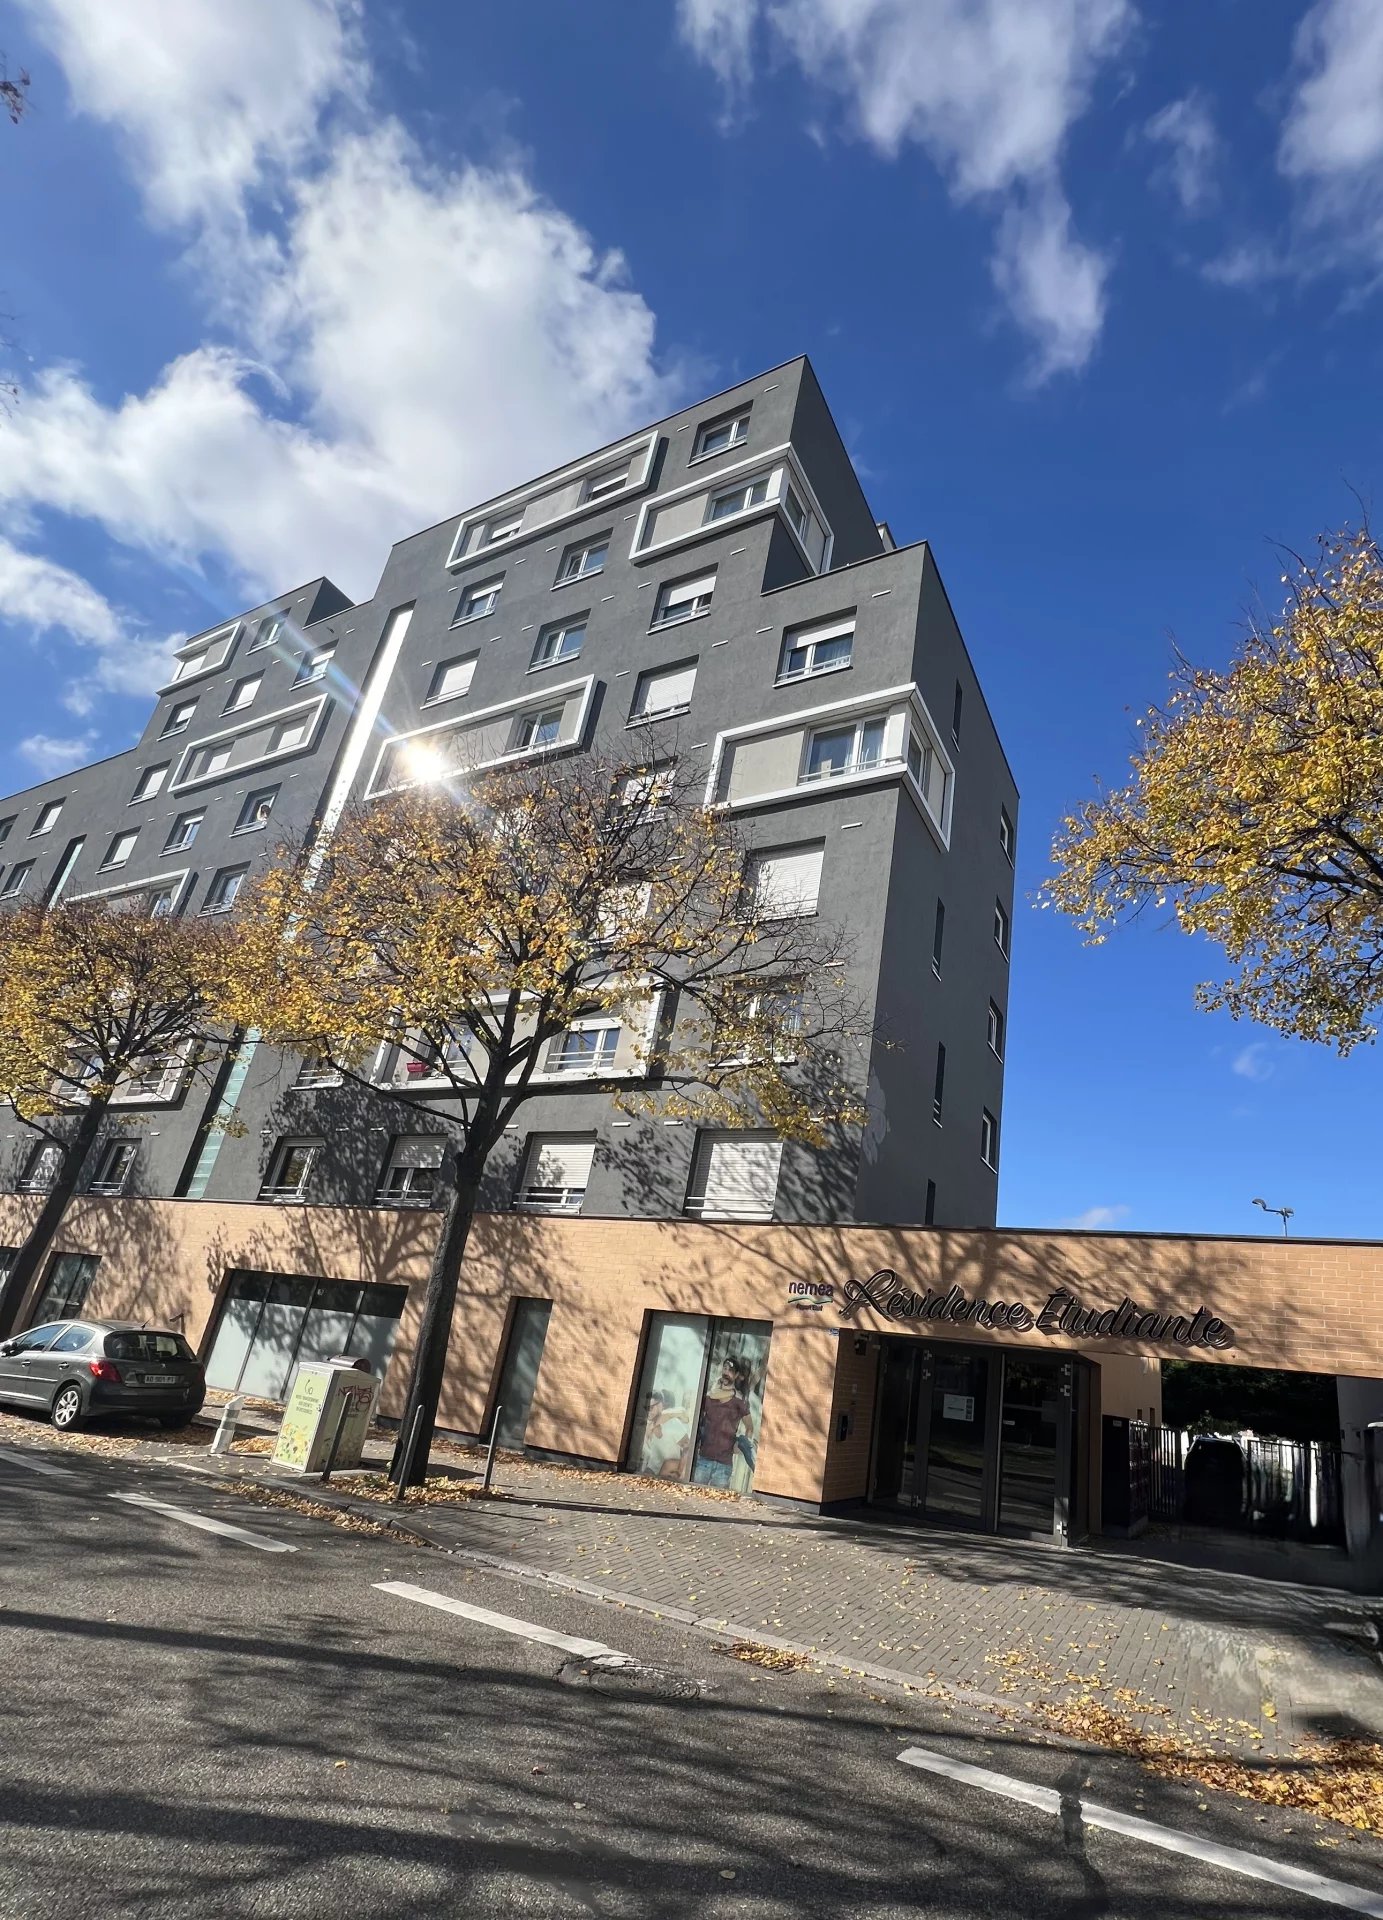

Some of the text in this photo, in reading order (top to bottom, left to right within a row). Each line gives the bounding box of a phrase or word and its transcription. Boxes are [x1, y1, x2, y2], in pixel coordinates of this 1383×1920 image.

[788, 1281, 834, 1297] nemea
[839, 1268, 1228, 1346] Résidence Étudiante
